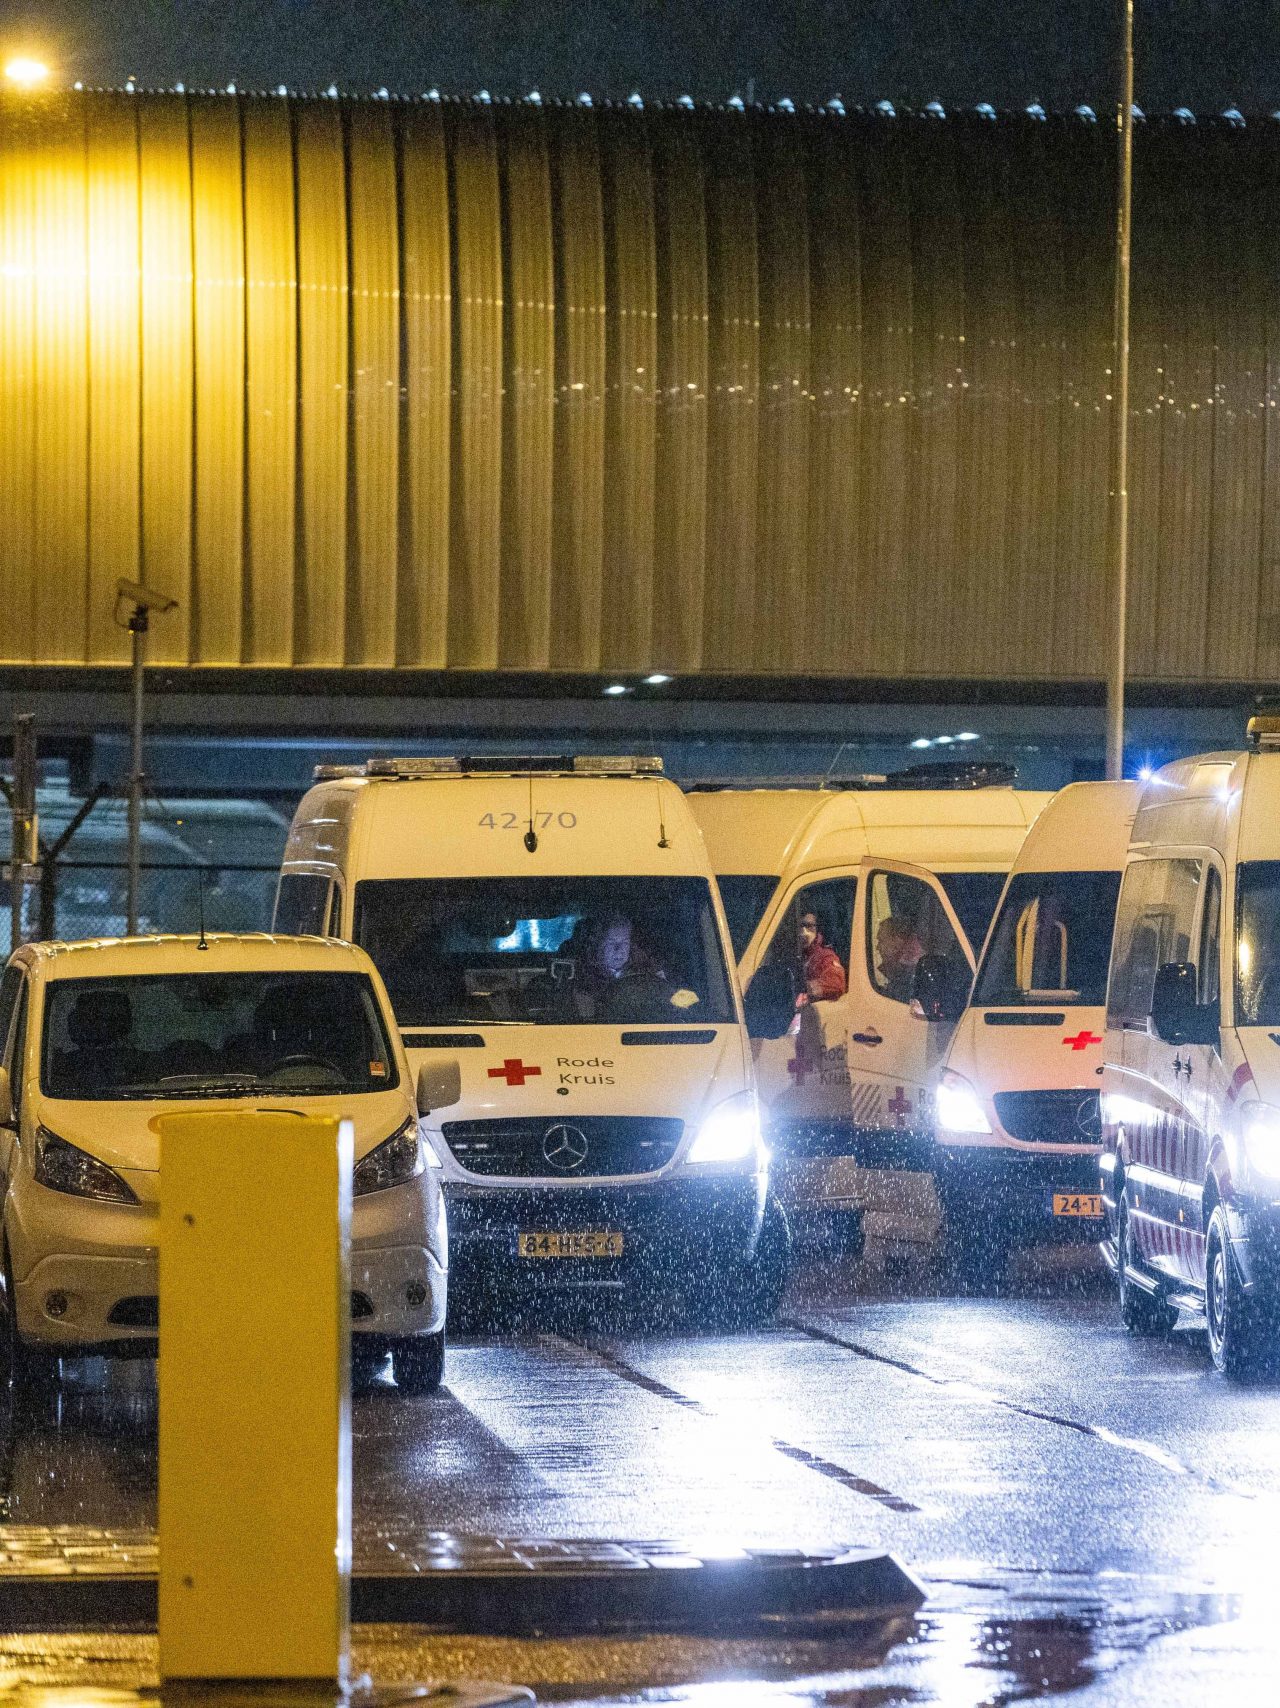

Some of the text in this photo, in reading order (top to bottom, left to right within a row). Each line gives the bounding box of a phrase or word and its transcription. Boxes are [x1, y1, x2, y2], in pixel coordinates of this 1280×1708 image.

[478, 812, 577, 830] 42-70
[819, 1044, 848, 1062] Rod
[556, 1057, 615, 1068] Rode
[559, 1073, 616, 1086] Kruis
